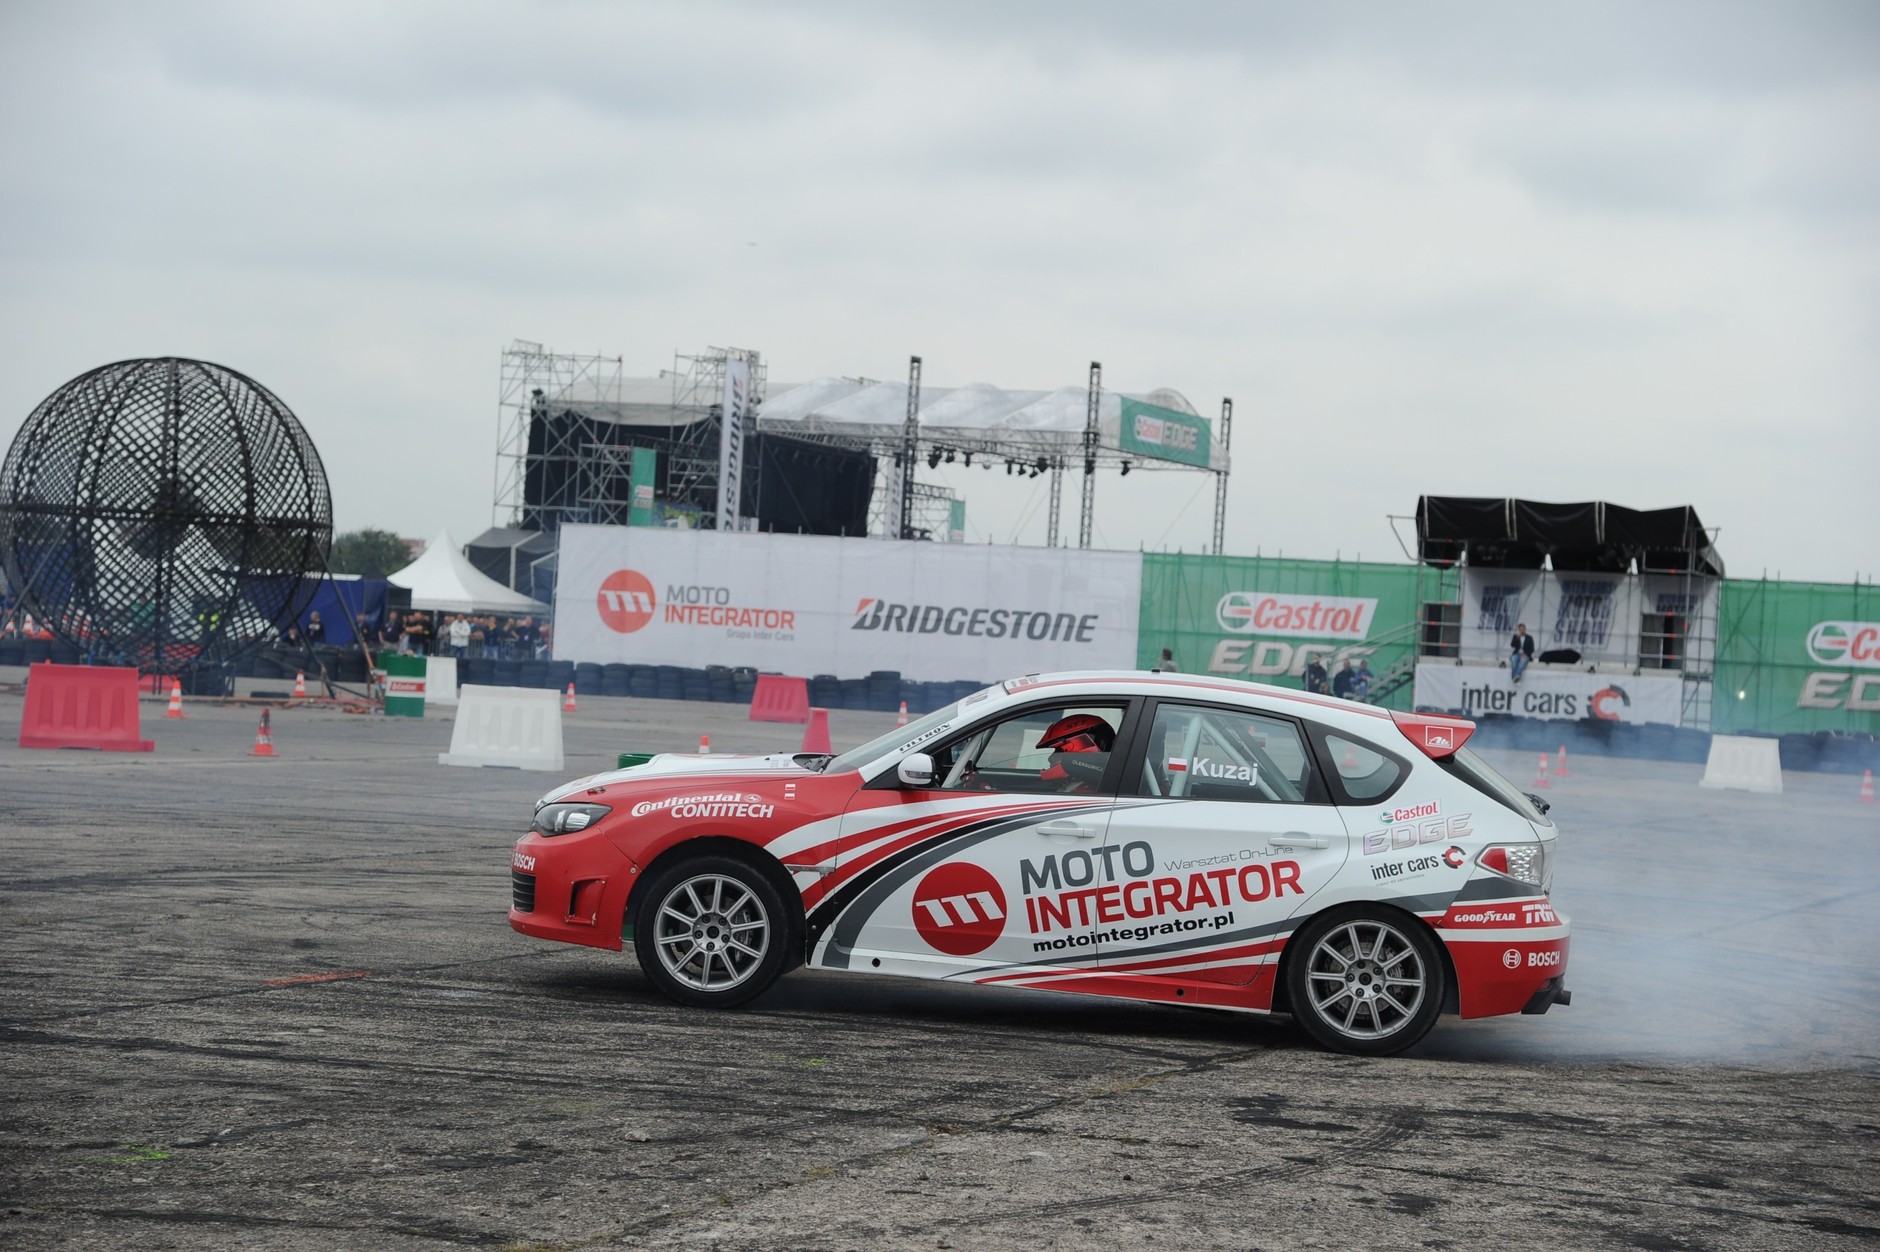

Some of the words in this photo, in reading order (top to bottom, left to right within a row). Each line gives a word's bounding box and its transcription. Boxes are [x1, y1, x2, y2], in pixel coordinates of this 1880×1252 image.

[1163, 421, 1198, 451] EDGE
[666, 585, 730, 605] MOTO
[665, 604, 795, 630] INTEGRATOR
[850, 598, 1099, 642] BRIDGESTONE
[1253, 598, 1365, 633] Castrol
[1851, 627, 1880, 662] C
[1461, 682, 1517, 713] inter
[1523, 691, 1577, 715] cars
[899, 723, 951, 752] FILTRON
[1192, 757, 1258, 786] Kuzaj
[631, 793, 741, 817] Continental
[671, 803, 775, 819] CONTITECH
[1395, 801, 1439, 821] Castrol
[1362, 813, 1474, 856] EDGE
[513, 852, 536, 871] BOSCH
[1019, 840, 1155, 895] MOTO
[1164, 852, 1237, 871] Warsztat
[1239, 845, 1294, 861] On-Line
[1370, 862, 1403, 880] inter
[1407, 855, 1439, 873] cars
[1025, 860, 1305, 934] INTEGRATOR
[1454, 910, 1516, 924] GOODYEAR
[1522, 903, 1555, 924] TRW
[1033, 911, 1235, 952] motointegrator.pl
[1527, 951, 1561, 967] BOSCH
